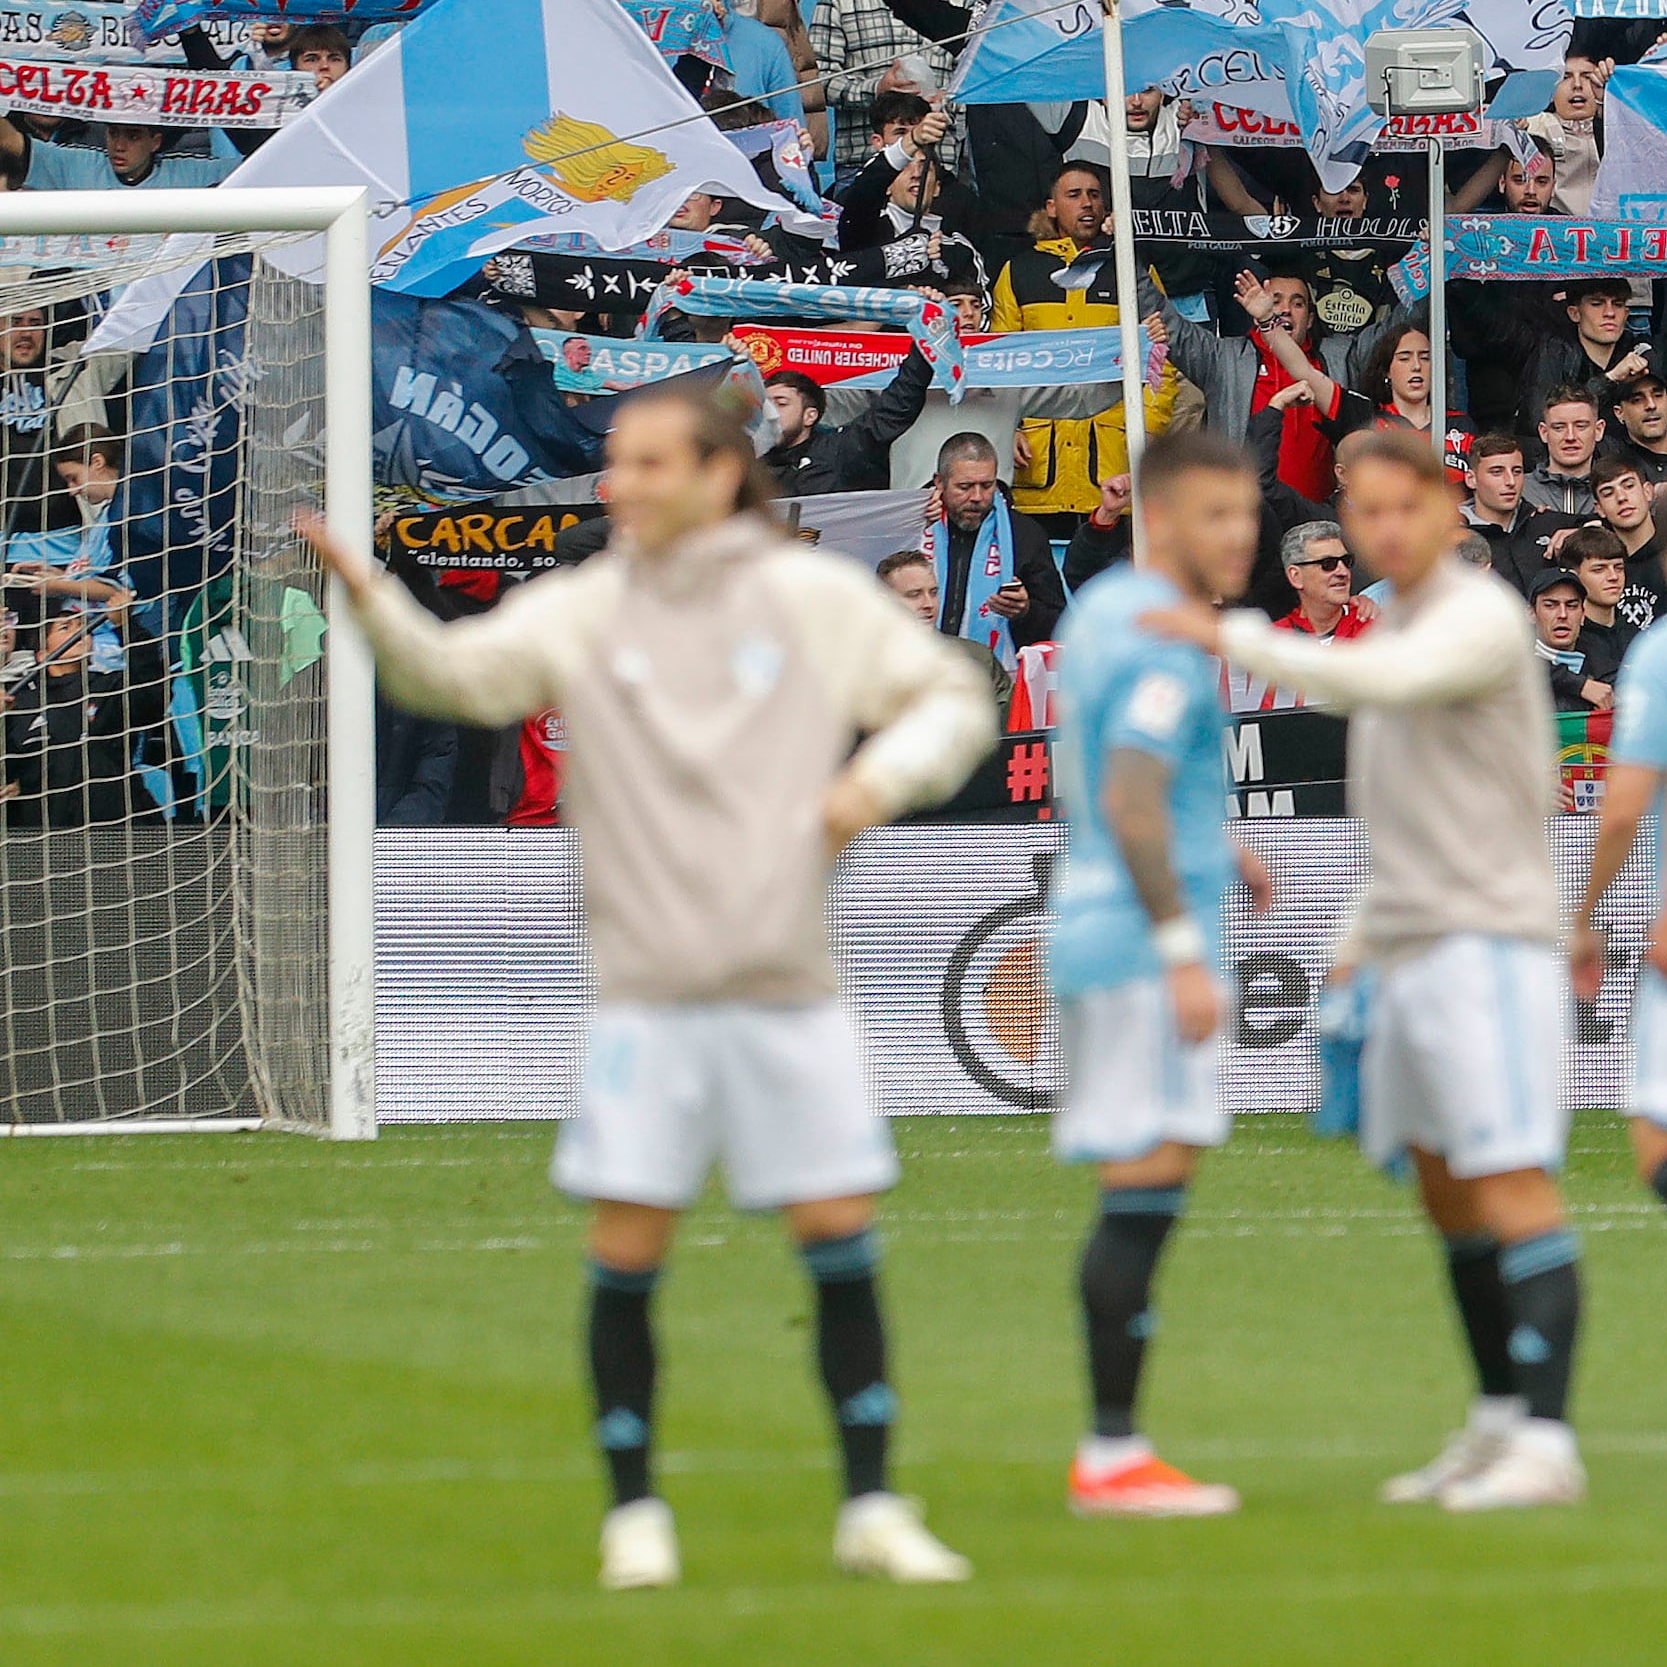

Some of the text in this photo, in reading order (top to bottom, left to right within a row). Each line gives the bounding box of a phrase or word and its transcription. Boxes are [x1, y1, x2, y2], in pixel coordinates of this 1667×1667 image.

[1323, 290, 1371, 309] Estrella
[1324, 308, 1368, 325] Galicia
[787, 347, 1094, 370] RCCelta UNITED
